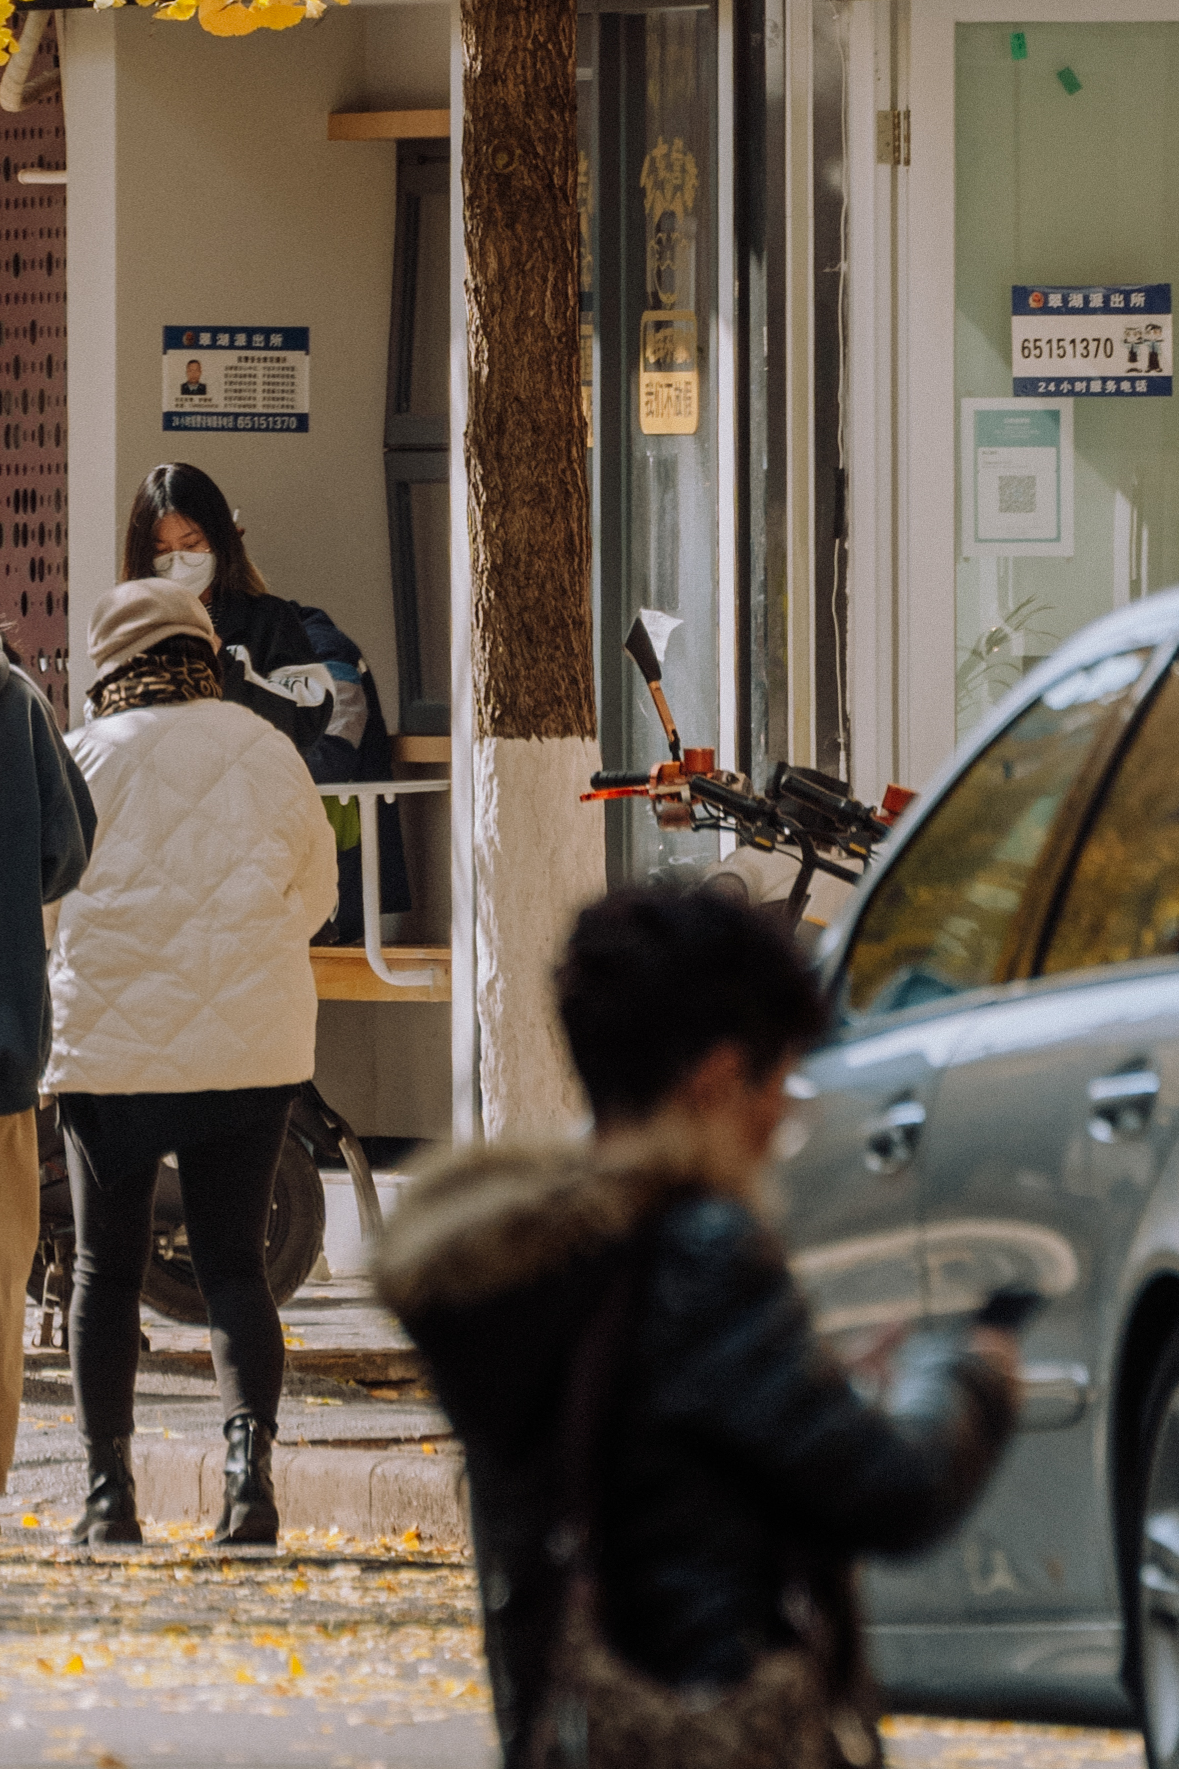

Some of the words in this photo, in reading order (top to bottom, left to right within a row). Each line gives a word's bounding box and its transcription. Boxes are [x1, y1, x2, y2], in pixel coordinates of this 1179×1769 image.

[1048, 293, 1146, 308] 翠湖派出所
[199, 332, 283, 346] 翠湖派出所
[1021, 338, 1114, 359] 65151370
[1038, 380, 1148, 393] 24小时服务电话
[237, 417, 297, 429] 65151370
